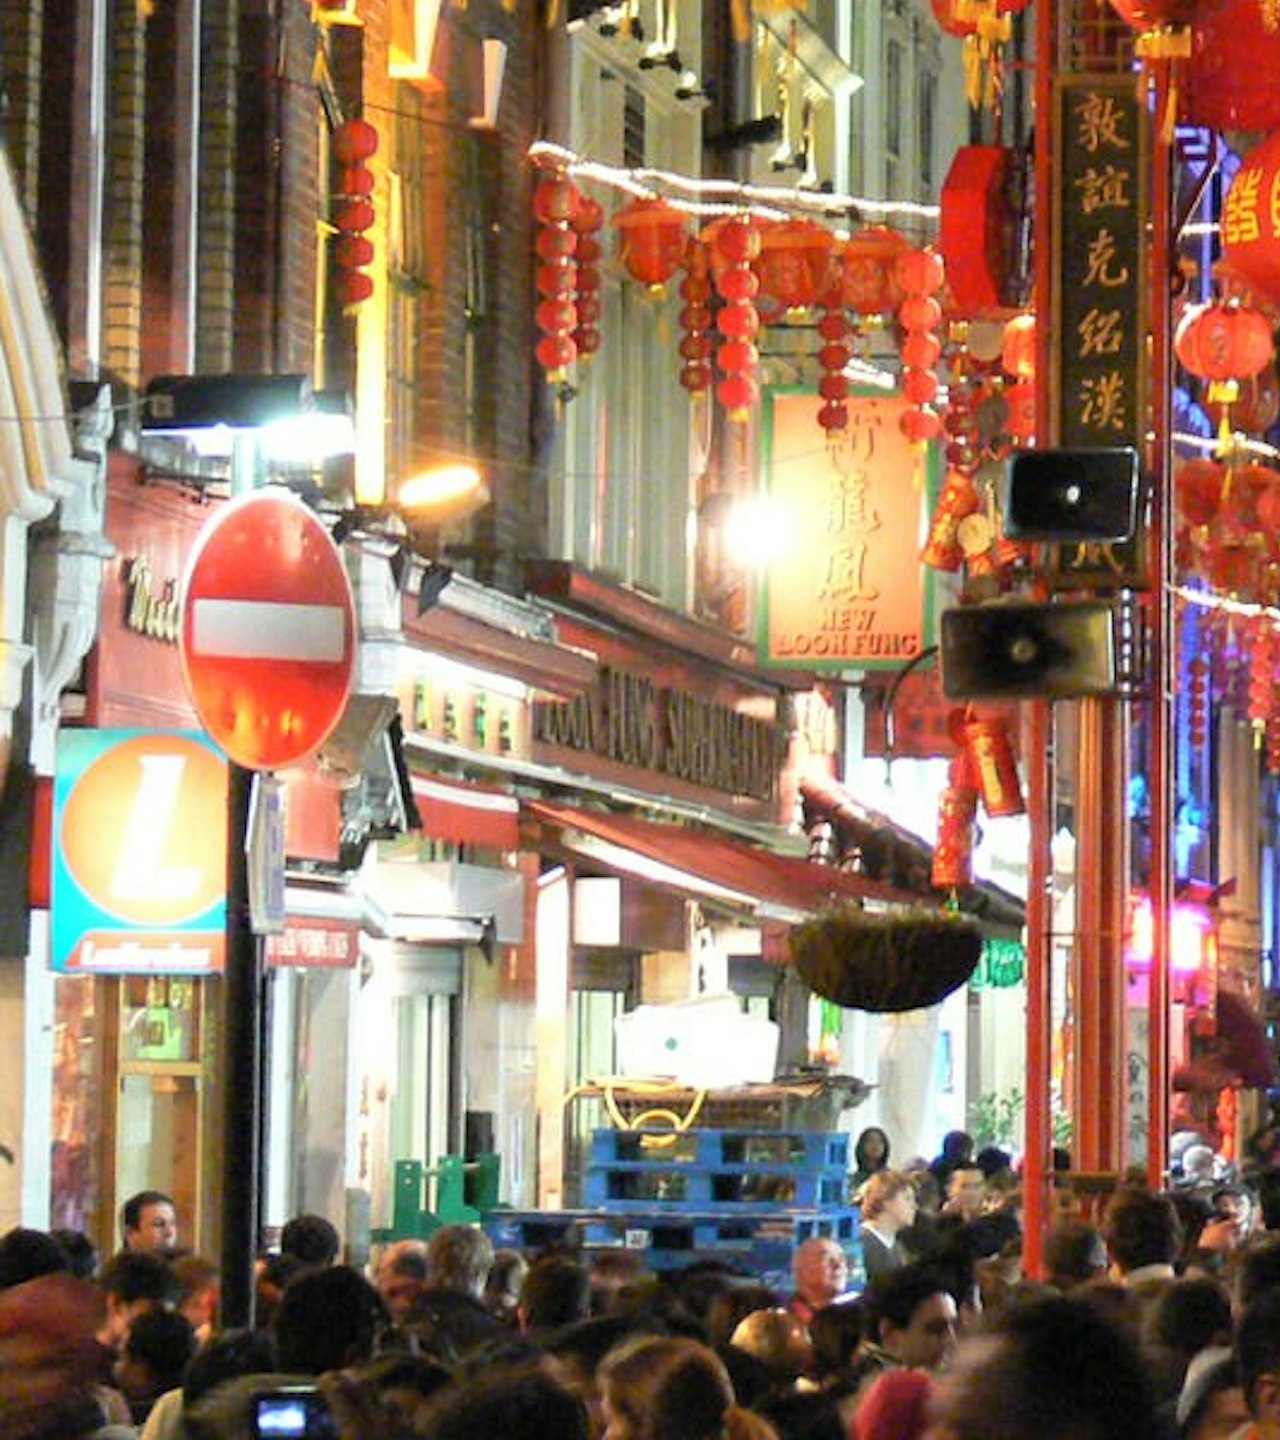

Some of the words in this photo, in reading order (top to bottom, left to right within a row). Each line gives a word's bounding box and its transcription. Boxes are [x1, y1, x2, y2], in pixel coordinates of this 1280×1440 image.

[1074, 93, 1131, 574] 敦誼克紹漢
[776, 635, 849, 656] LOON
[852, 634, 917, 656] FUNG
[822, 610, 876, 632] NEW
[110, 754, 203, 898] L
